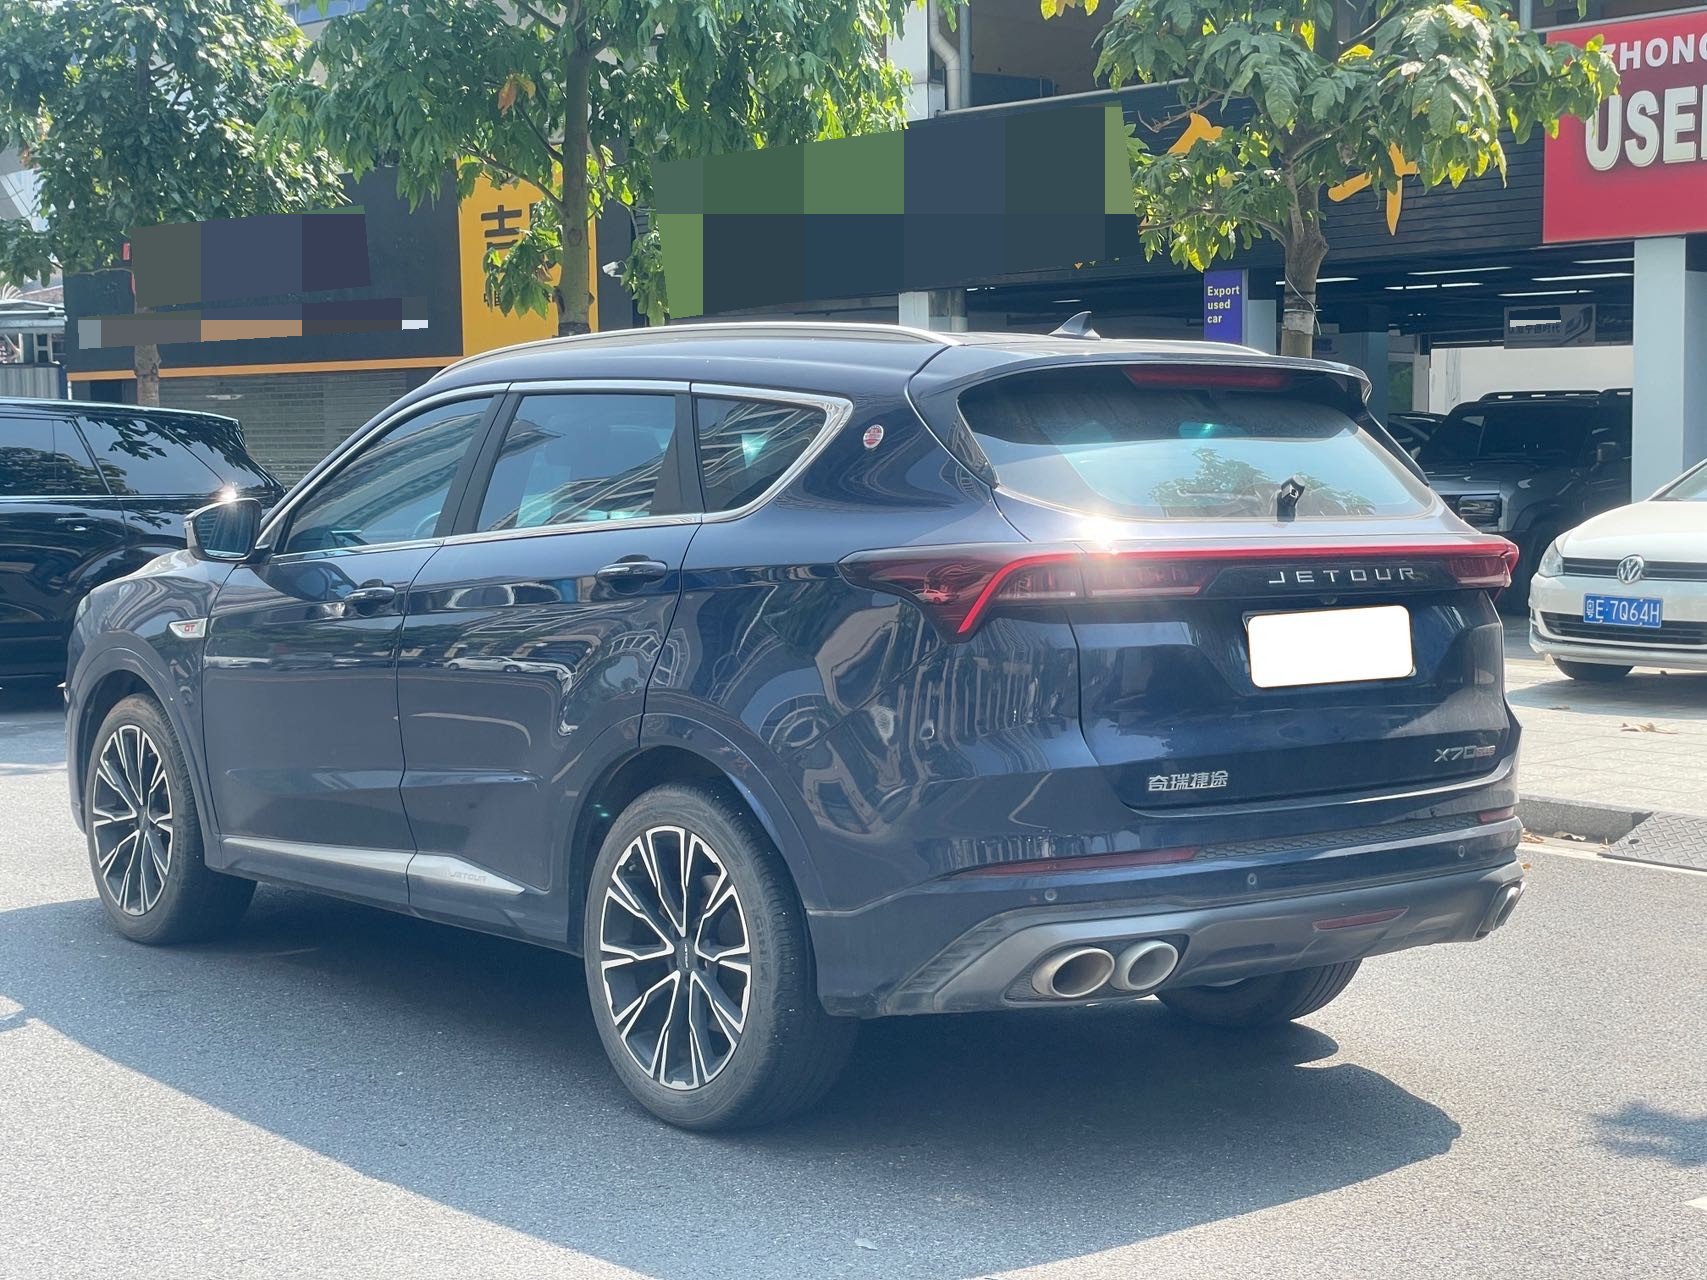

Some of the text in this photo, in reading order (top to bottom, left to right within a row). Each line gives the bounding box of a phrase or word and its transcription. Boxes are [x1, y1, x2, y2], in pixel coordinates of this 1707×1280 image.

[1585, 84, 1707, 171] USE
[1207, 285, 1240, 298] Export
[1207, 298, 1231, 310] used
[1207, 315, 1223, 324] car
[1268, 567, 1416, 585] JETOUR
[184, 624, 196, 632] GT
[1148, 770, 1229, 792] 奇瑞捷途
